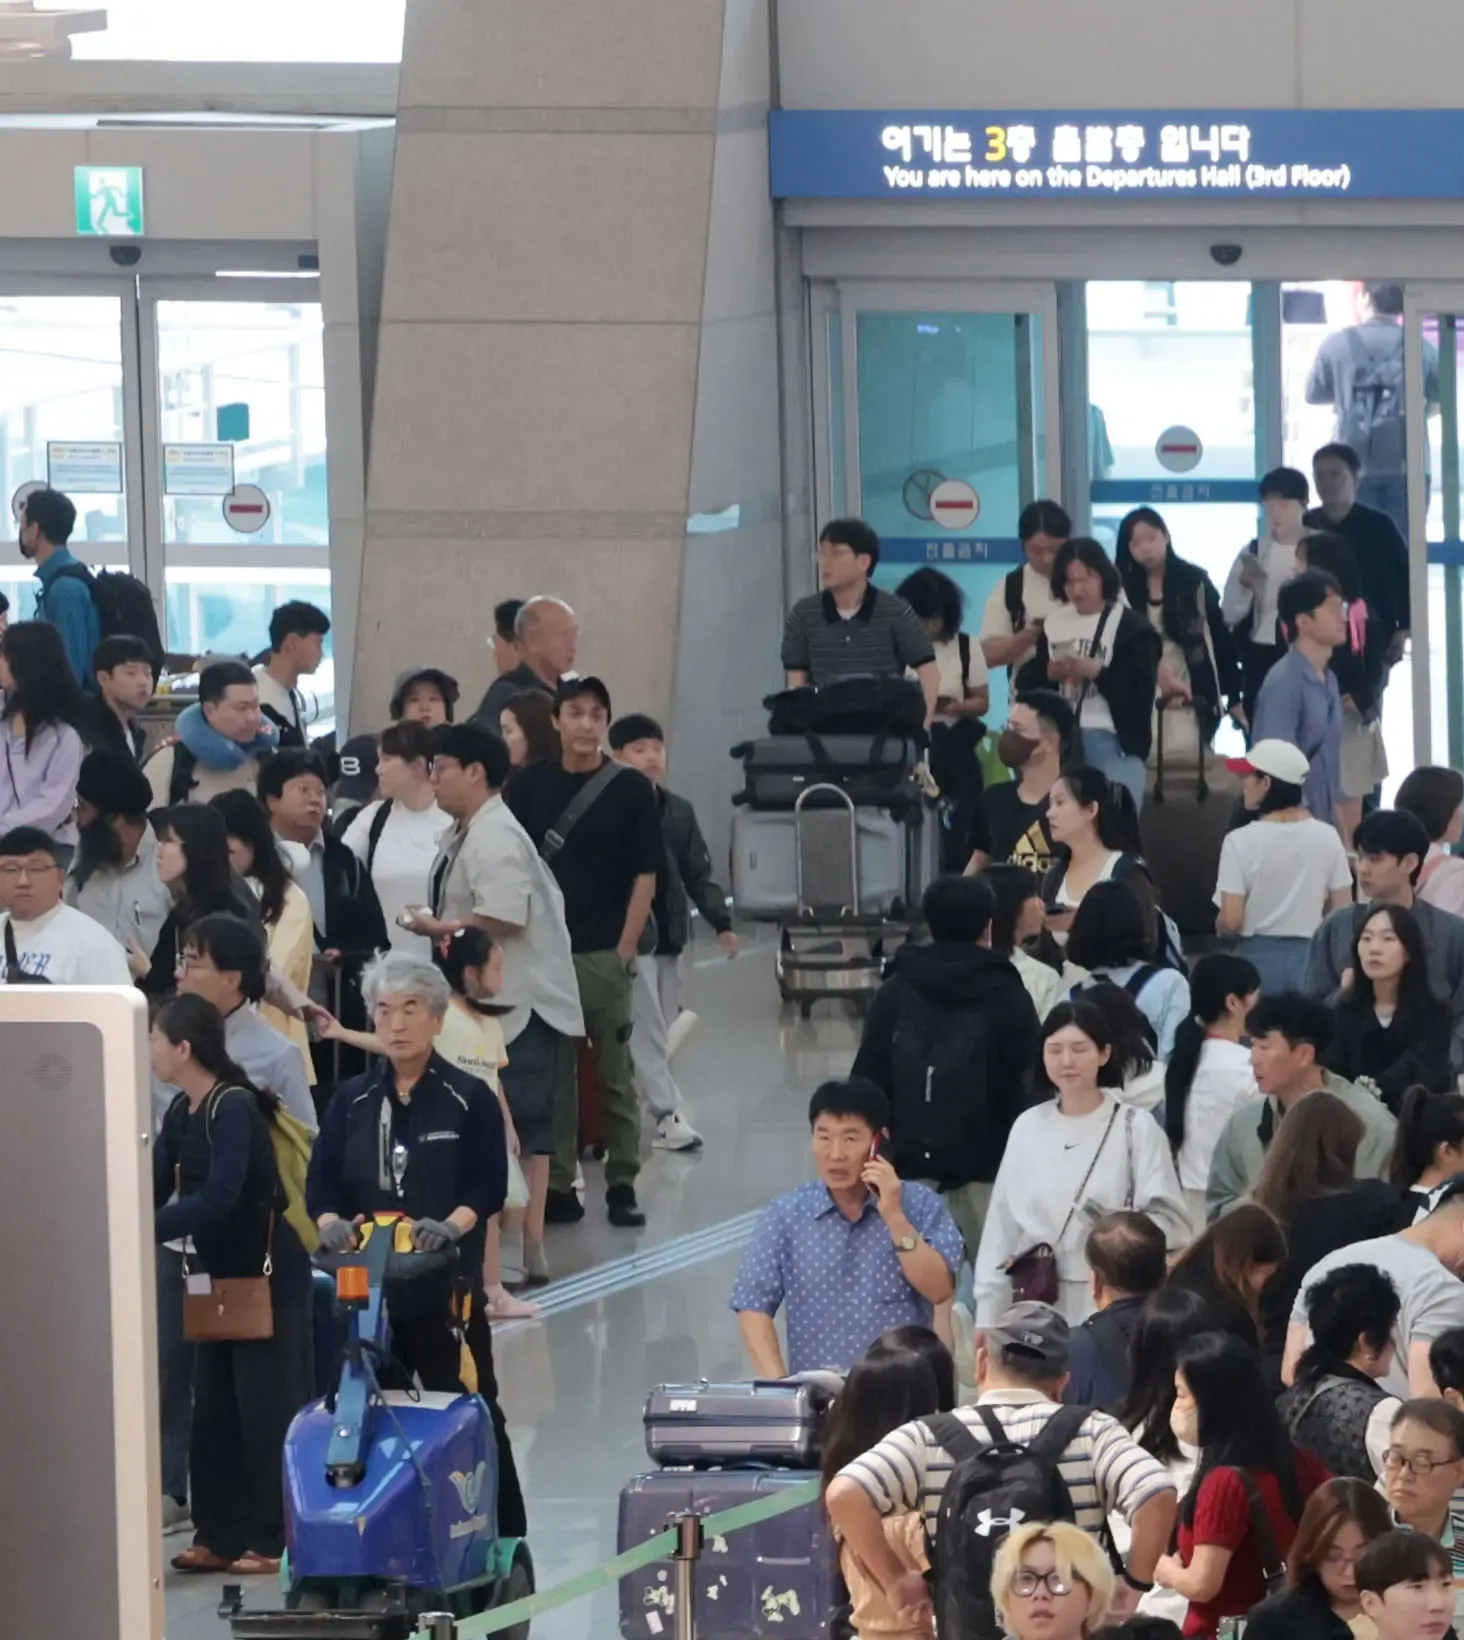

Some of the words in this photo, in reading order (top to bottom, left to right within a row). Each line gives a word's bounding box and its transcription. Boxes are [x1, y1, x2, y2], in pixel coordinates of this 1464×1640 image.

[882, 126, 973, 163] 여기는
[985, 126, 1037, 163] 3층
[1160, 126, 1251, 163] 입니다
[883, 166, 922, 188] You
[928, 169, 959, 188] are
[965, 166, 1012, 188] here
[1015, 169, 1043, 188] on
[1047, 166, 1082, 188] the
[1087, 166, 1197, 192] Departures
[1201, 166, 1241, 188] Hall
[1246, 165, 1286, 191] (3rd
[1291, 165, 1352, 191] Floor)
